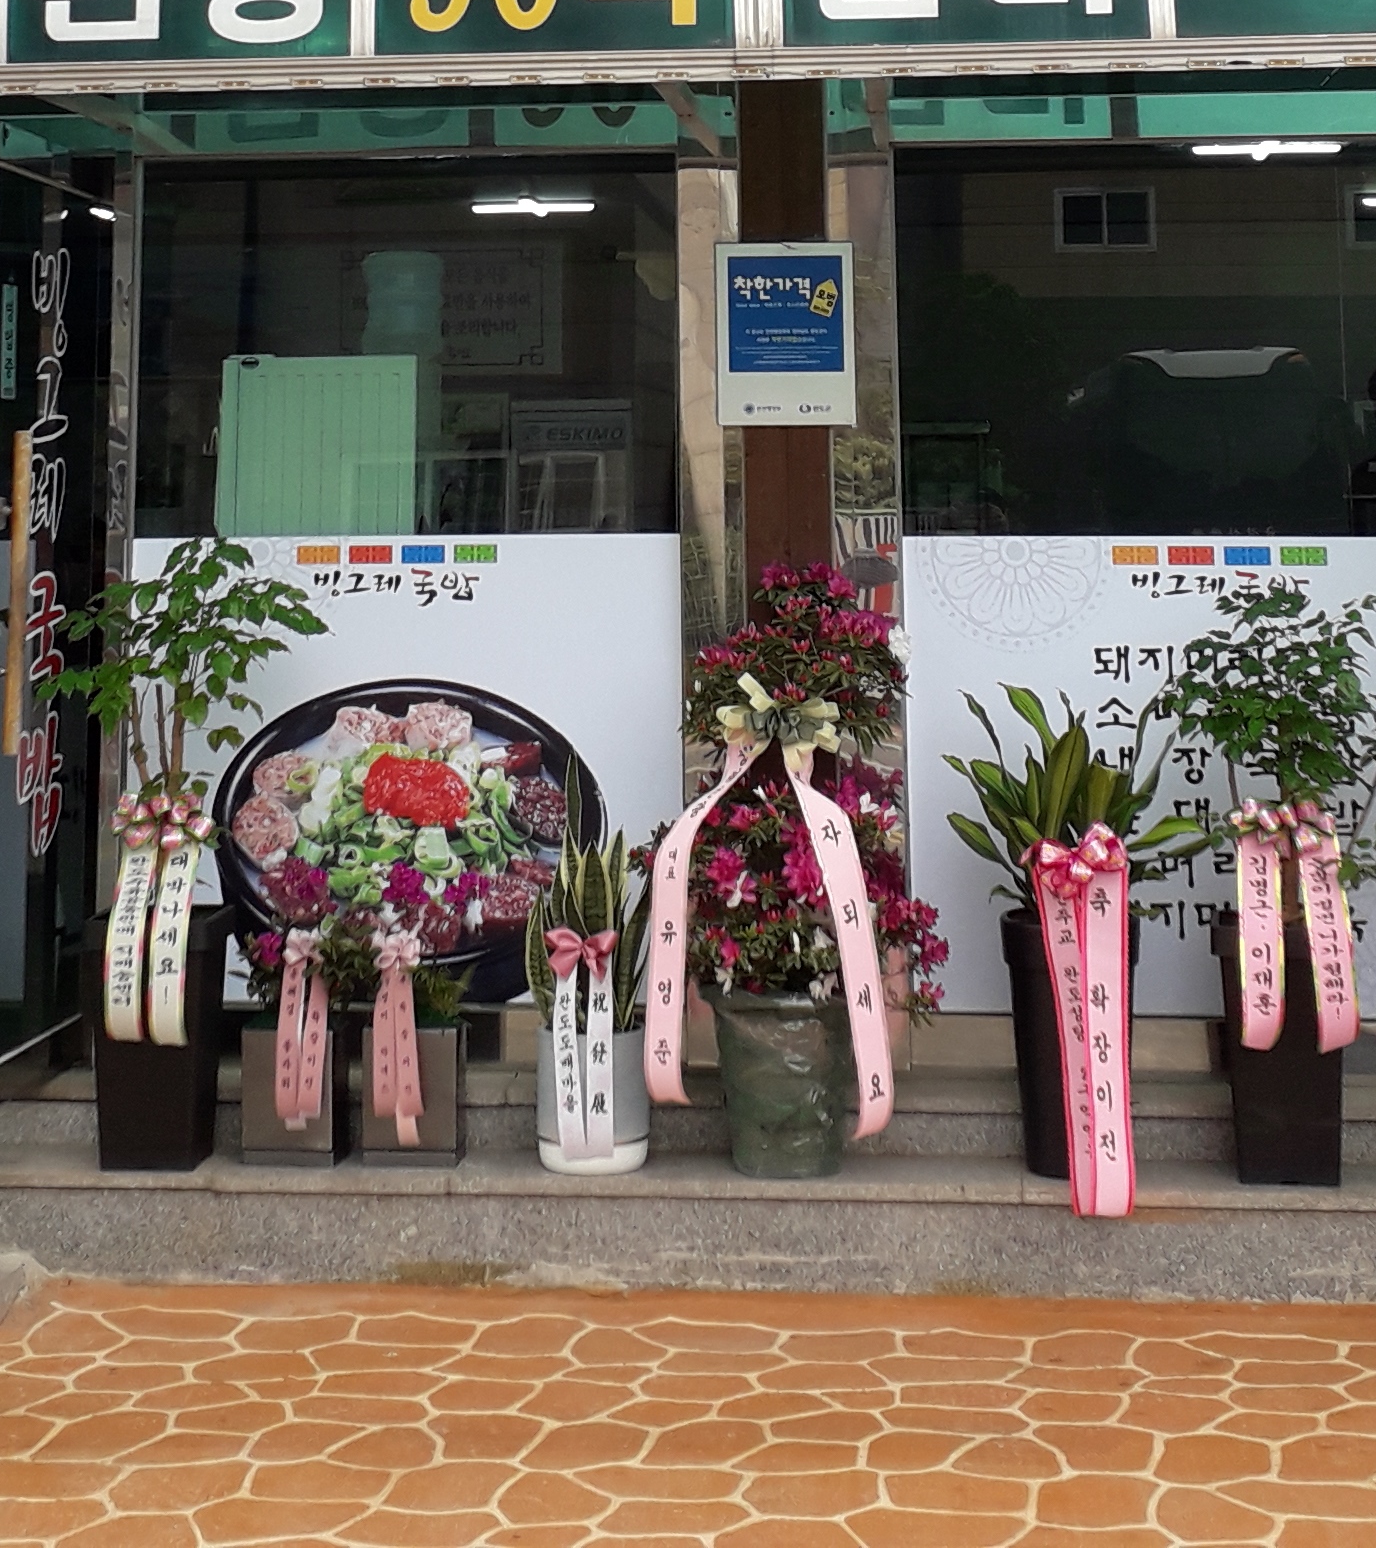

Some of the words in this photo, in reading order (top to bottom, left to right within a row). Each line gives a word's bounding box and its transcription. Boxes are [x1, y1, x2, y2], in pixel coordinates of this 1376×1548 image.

[733, 275, 811, 300] 착한가격
[546, 427, 624, 441] ESKIMO
[313, 570, 401, 600] 빙그레
[410, 567, 481, 607] 국밥
[1131, 571, 1226, 599] 빙그레
